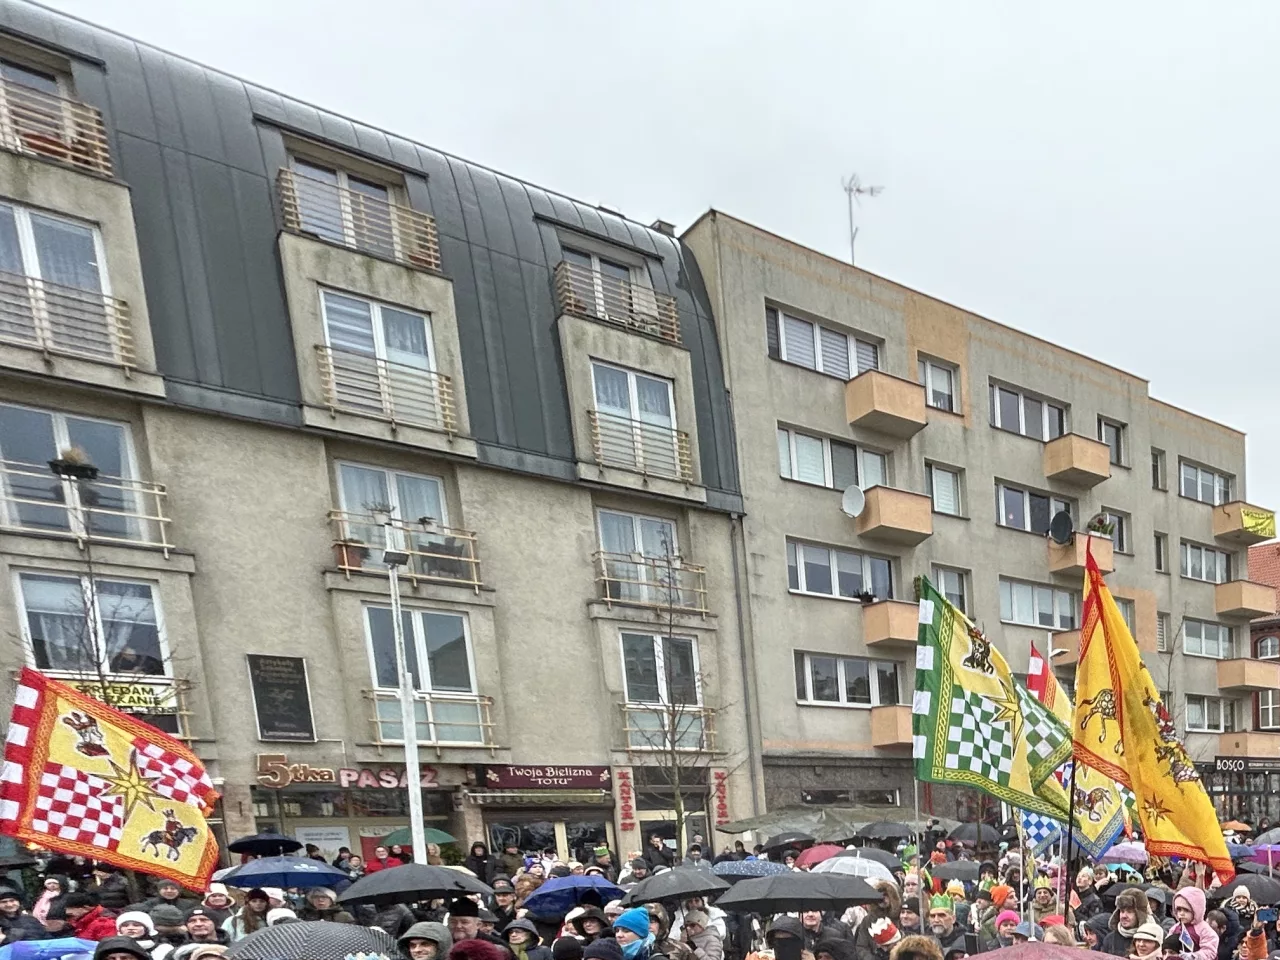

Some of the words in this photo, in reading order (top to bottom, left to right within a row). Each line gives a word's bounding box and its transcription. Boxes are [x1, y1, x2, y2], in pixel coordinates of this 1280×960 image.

[257, 753, 336, 788] 5tka
[507, 767, 542, 777] Twoja
[545, 766, 592, 776] Bielizna
[1216, 760, 1244, 770] BOSCO
[617, 771, 634, 819] KANTOR
[714, 772, 728, 817] KANTOR
